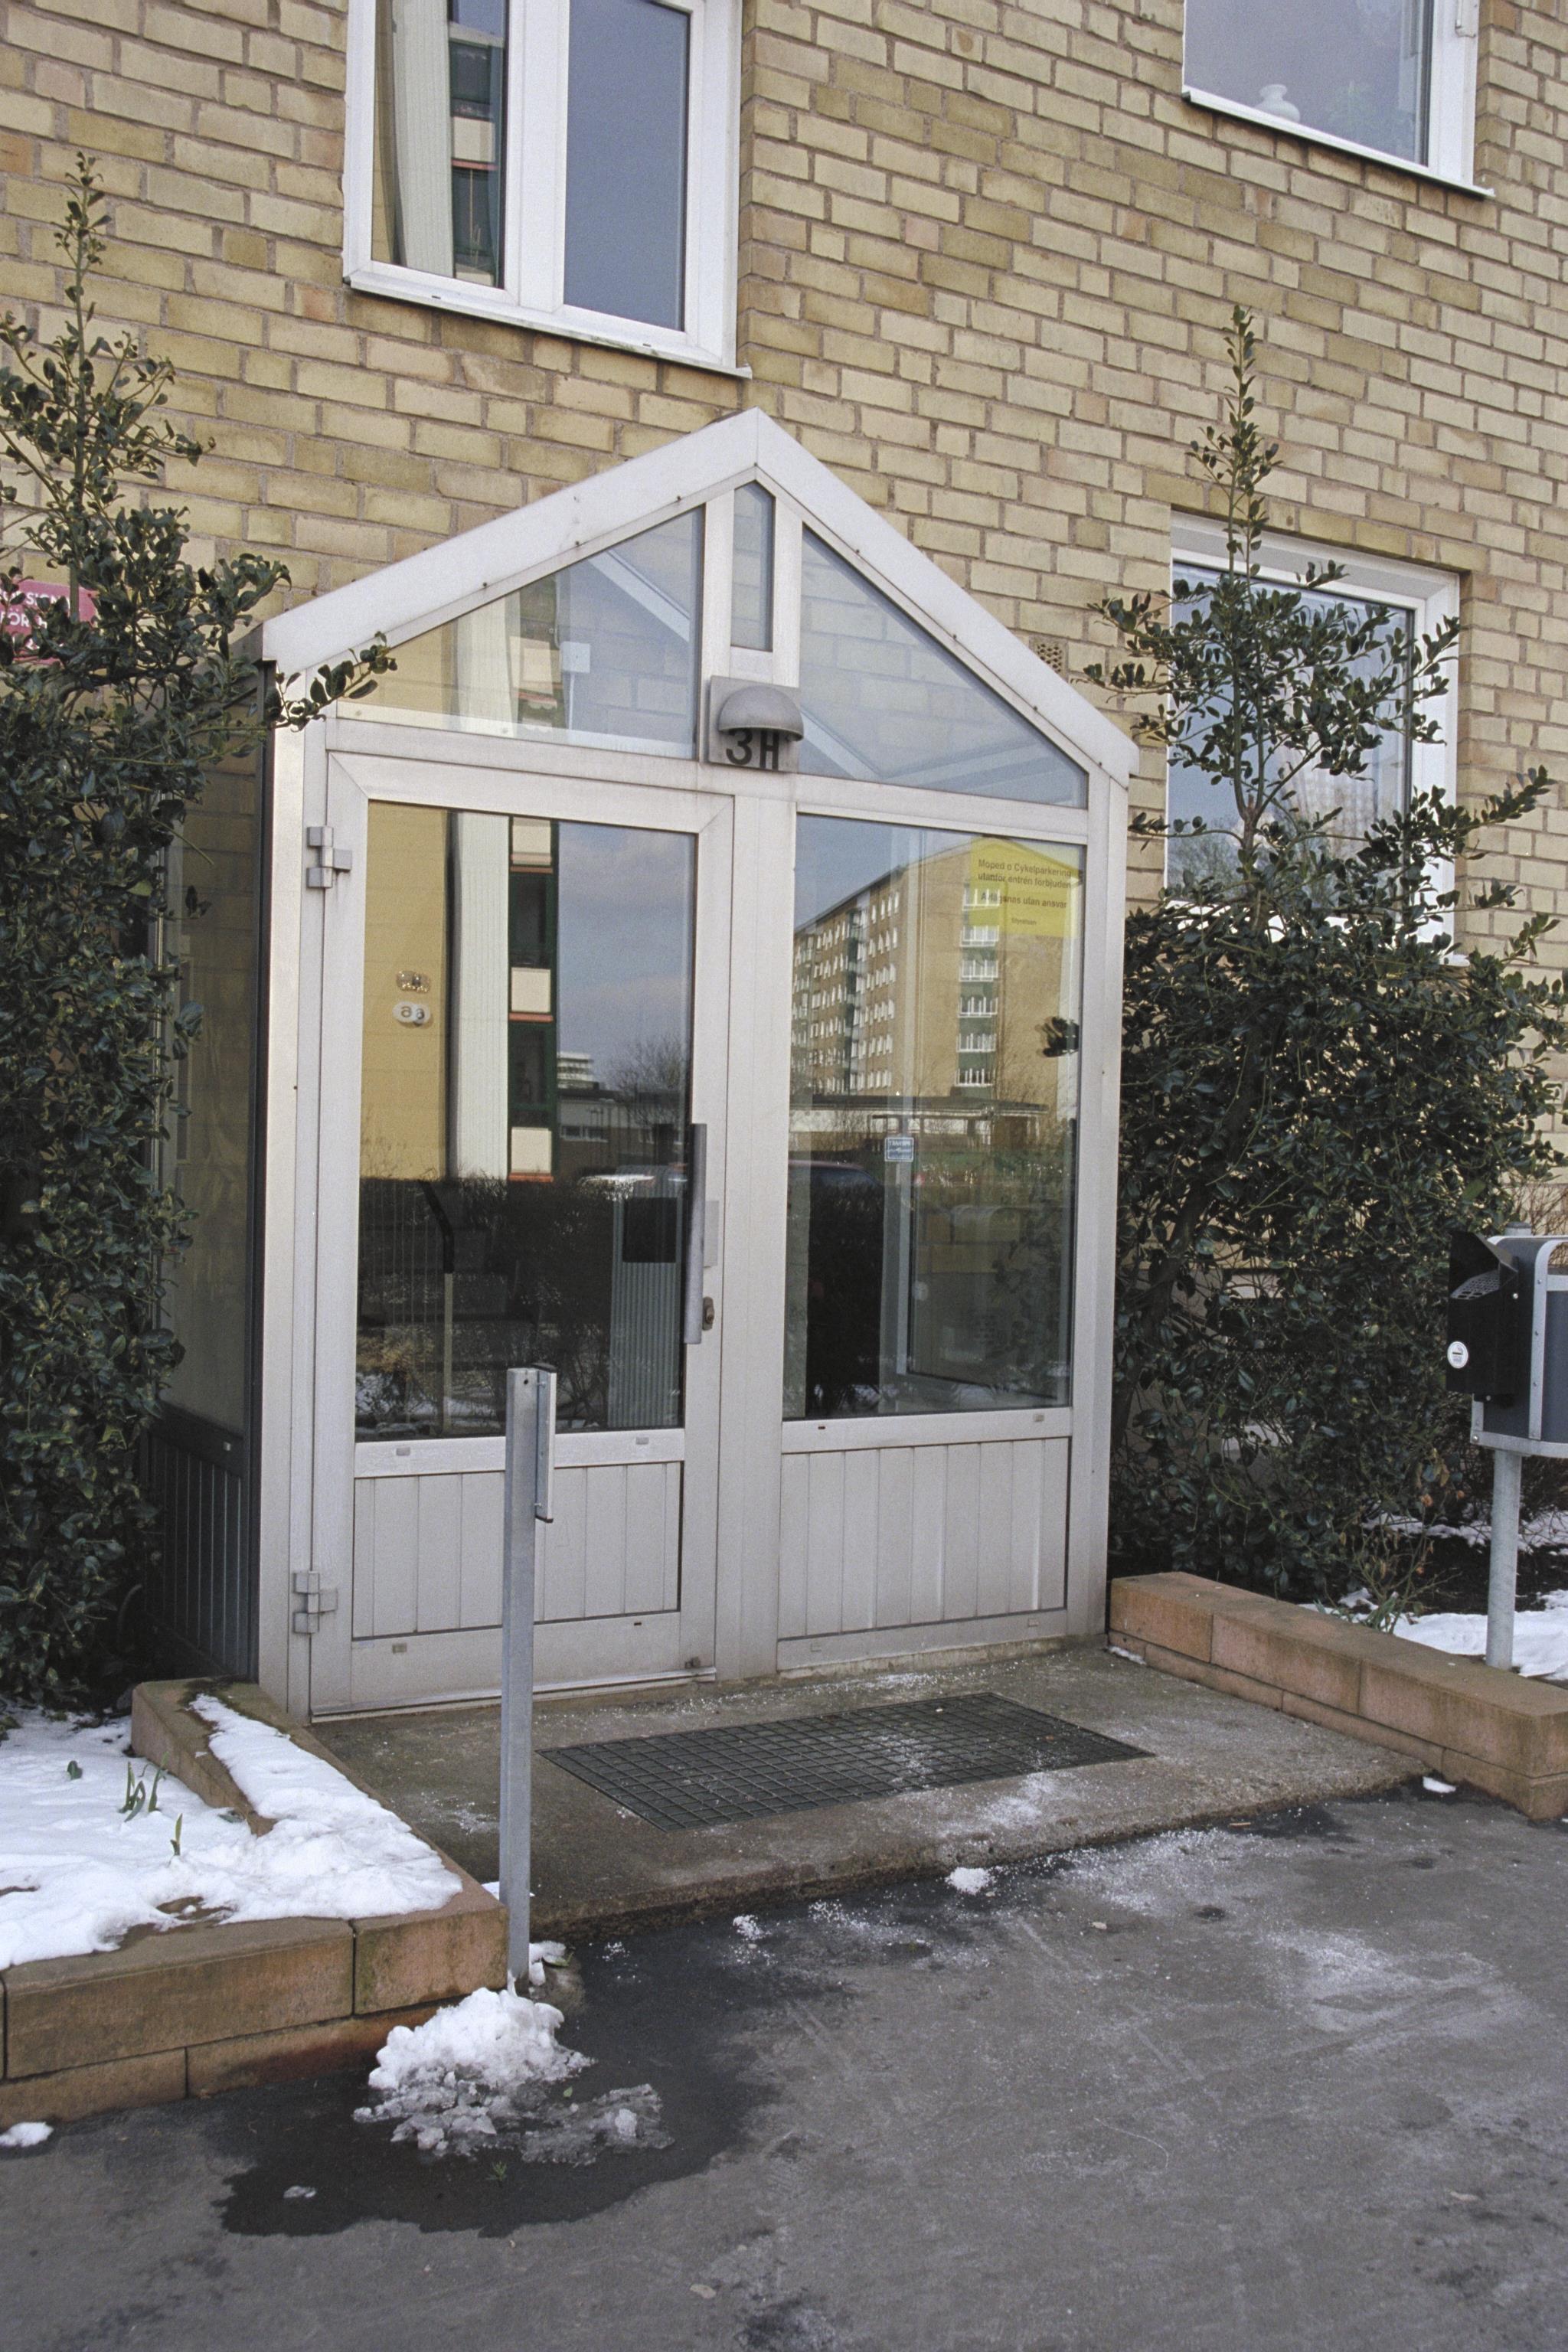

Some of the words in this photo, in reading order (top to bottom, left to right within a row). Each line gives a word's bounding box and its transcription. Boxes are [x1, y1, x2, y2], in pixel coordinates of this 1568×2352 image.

[726, 728, 779, 772] 3H
[978, 859, 1005, 870] Moped
[1014, 864, 1072, 878] Cykelparkering
[1023, 897, 1040, 906] utan
[1042, 900, 1067, 909] ansvar
